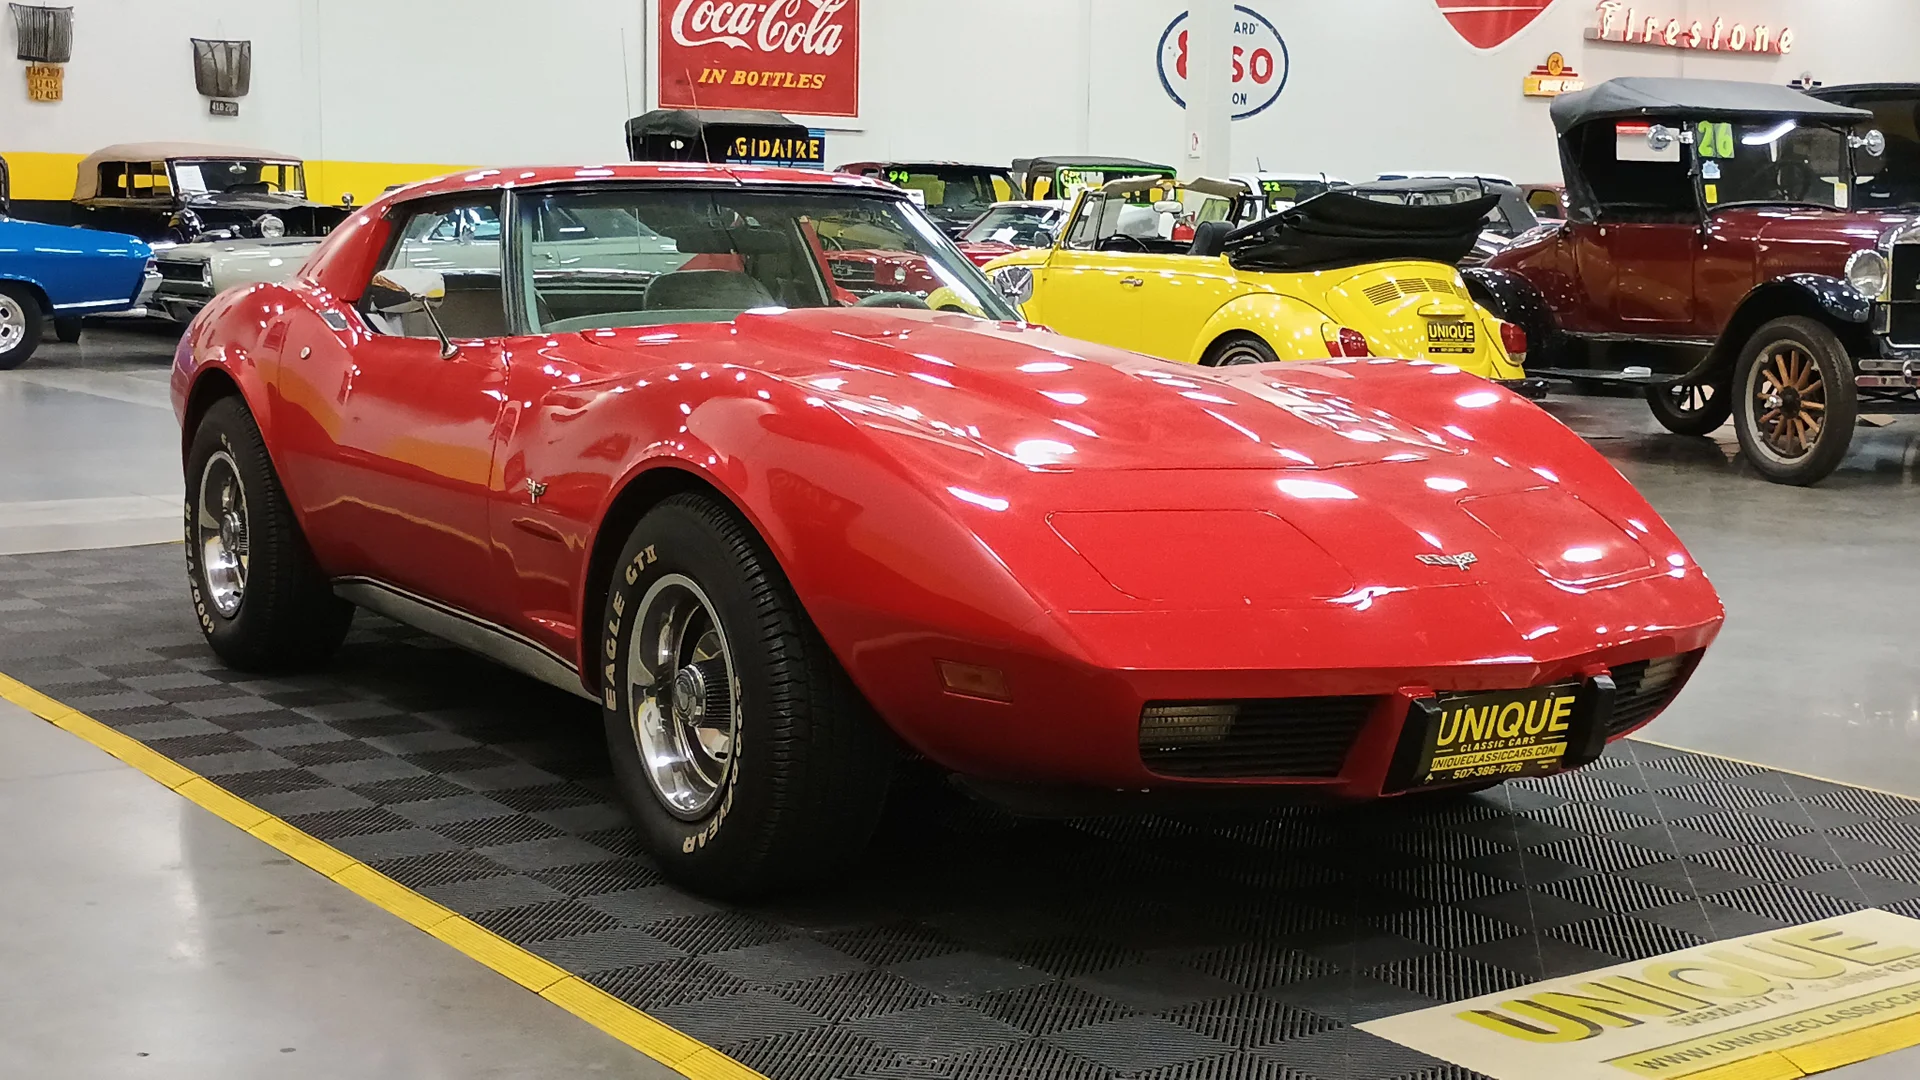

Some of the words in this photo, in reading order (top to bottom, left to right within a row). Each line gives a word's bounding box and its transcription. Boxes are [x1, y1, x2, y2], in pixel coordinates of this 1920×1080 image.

[671, 0, 843, 56] Coca-Cola
[1597, 0, 1794, 54] Firestone
[698, 68, 727, 84] IN
[730, 70, 826, 89] BOTTLES
[727, 137, 820, 160] GIDAIRE
[1698, 120, 1734, 158] 26
[889, 171, 909, 183] 94
[1262, 181, 1280, 192] 22
[1428, 323, 1474, 339] UNIQUE
[605, 591, 626, 711] EAGLE
[1437, 696, 1575, 746] UNIQUE
[1460, 740, 1505, 753] CLASSIC
[1508, 735, 1536, 747] CARS
[1452, 762, 1524, 780] 507-386-1726
[1455, 925, 1920, 1044] UNIQUE
